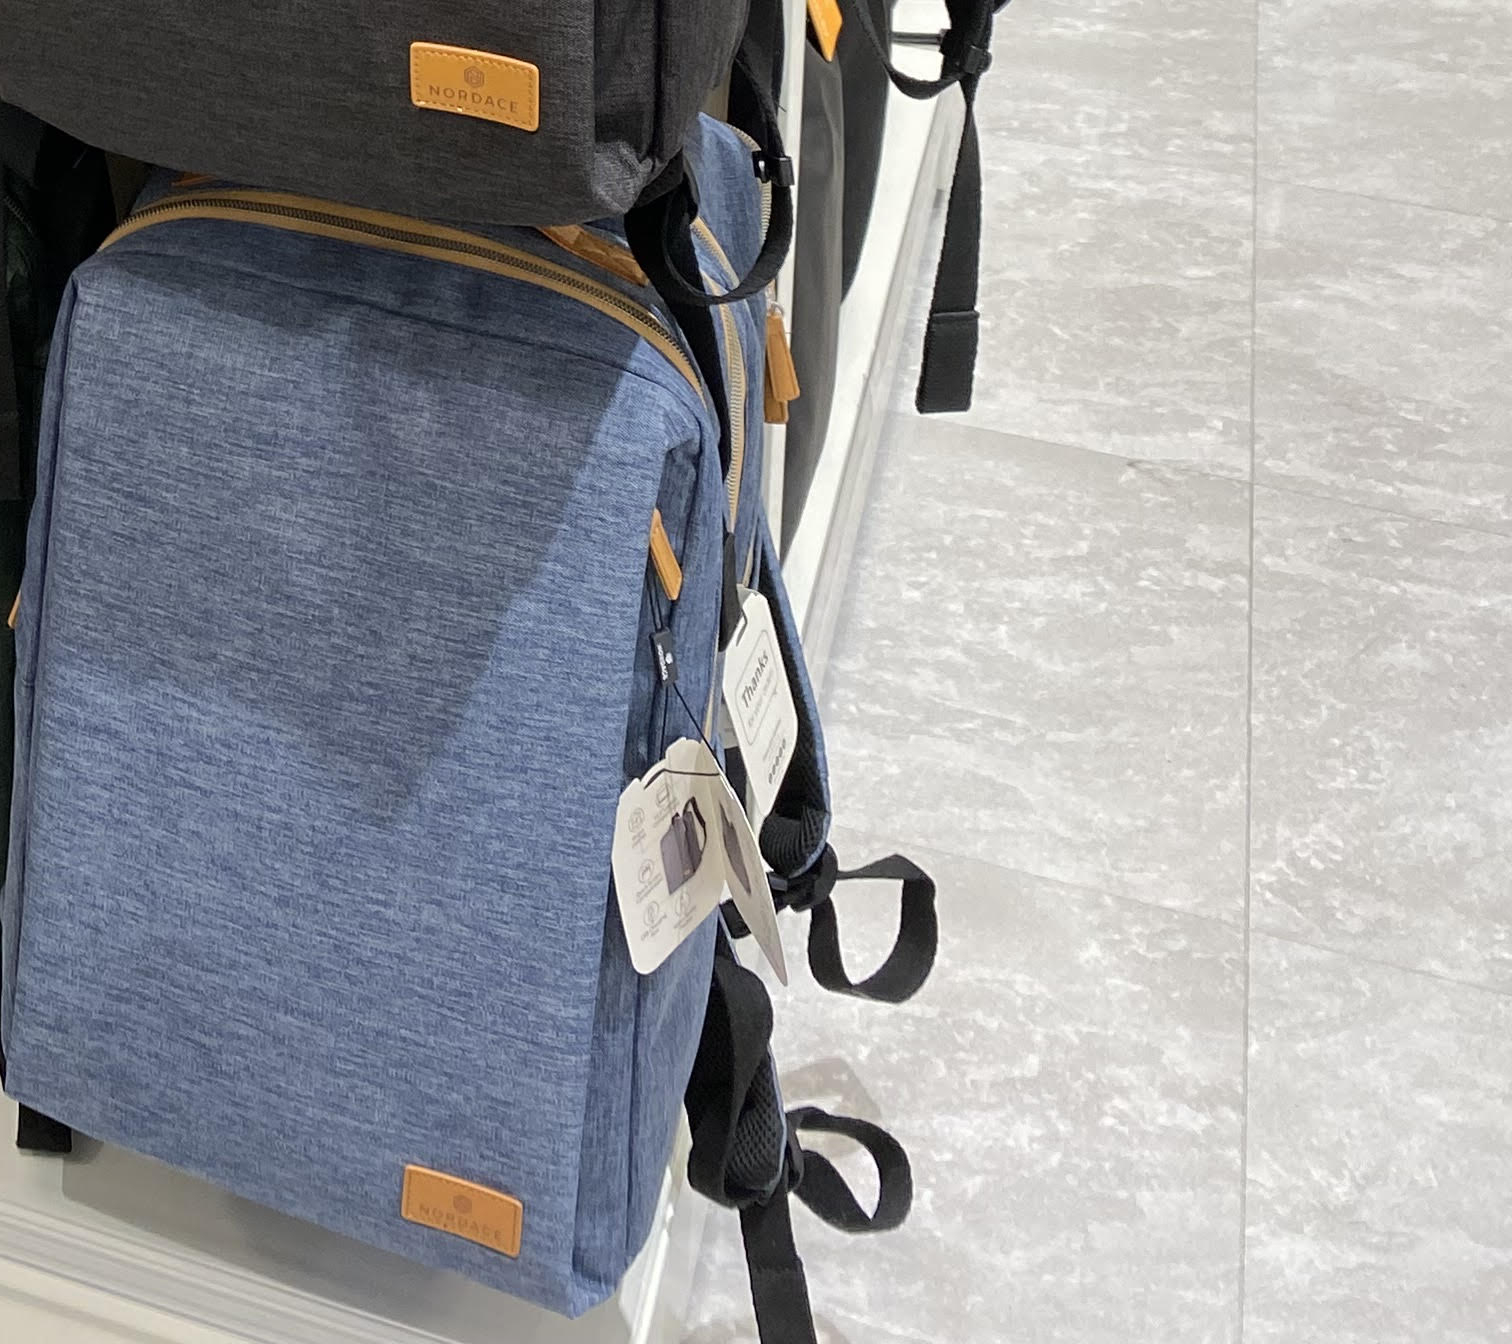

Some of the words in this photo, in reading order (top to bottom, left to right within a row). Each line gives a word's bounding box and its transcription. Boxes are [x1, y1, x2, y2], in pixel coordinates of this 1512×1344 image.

[429, 85, 519, 113] NORDACE
[741, 649, 769, 708] Thanks
[419, 1203, 503, 1240] NORDACE
